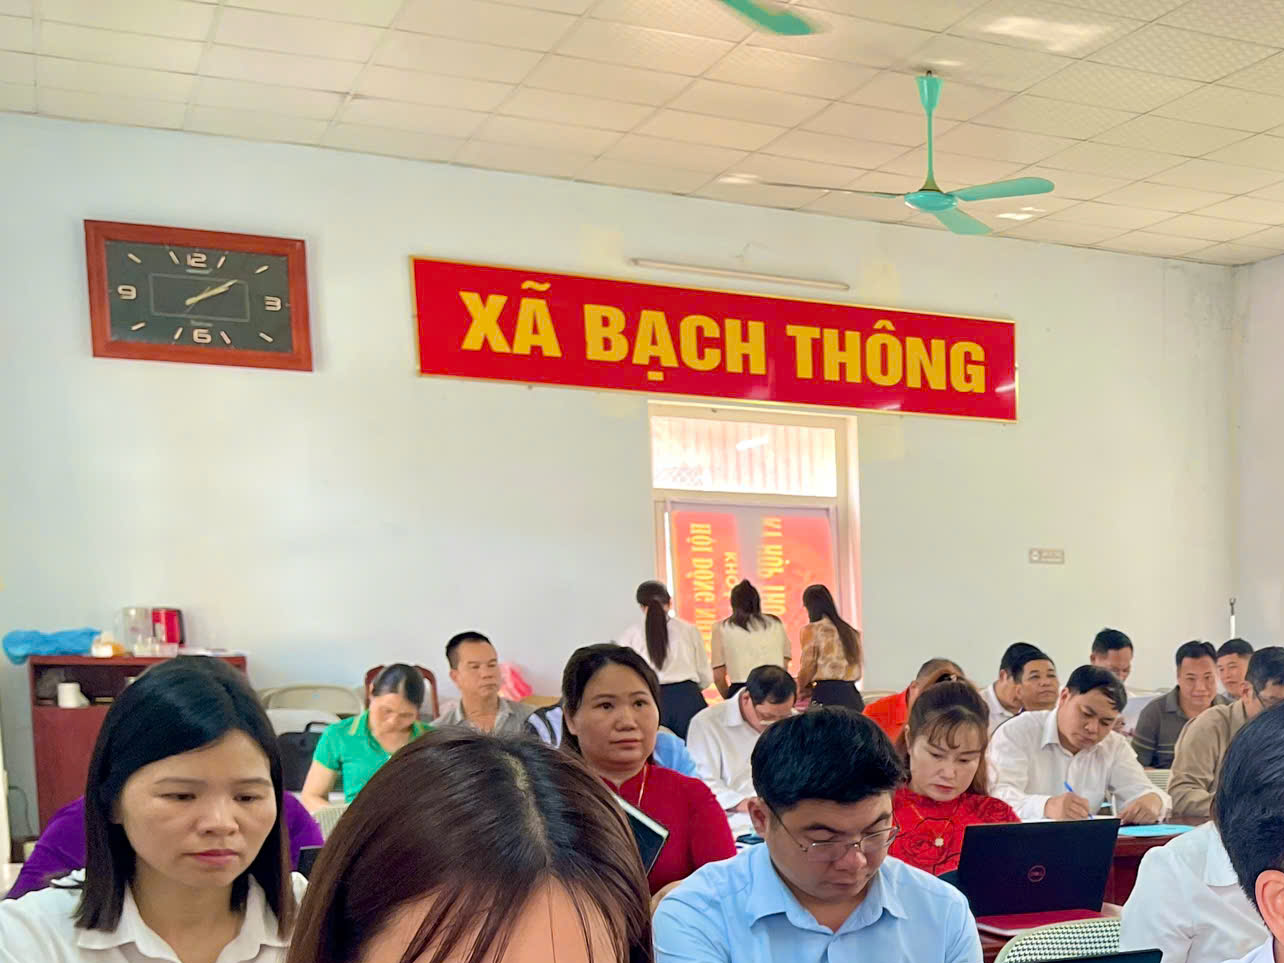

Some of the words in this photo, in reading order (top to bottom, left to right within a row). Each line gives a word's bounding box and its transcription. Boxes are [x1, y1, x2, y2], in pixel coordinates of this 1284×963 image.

[186, 252, 208, 268] 12
[117, 285, 137, 300] 9
[264, 296, 282, 312] 3
[192, 329, 212, 344] 6
[459, 280, 562, 358] XÃ
[583, 303, 766, 381] BẠCH
[786, 319, 986, 393] THÔNG
